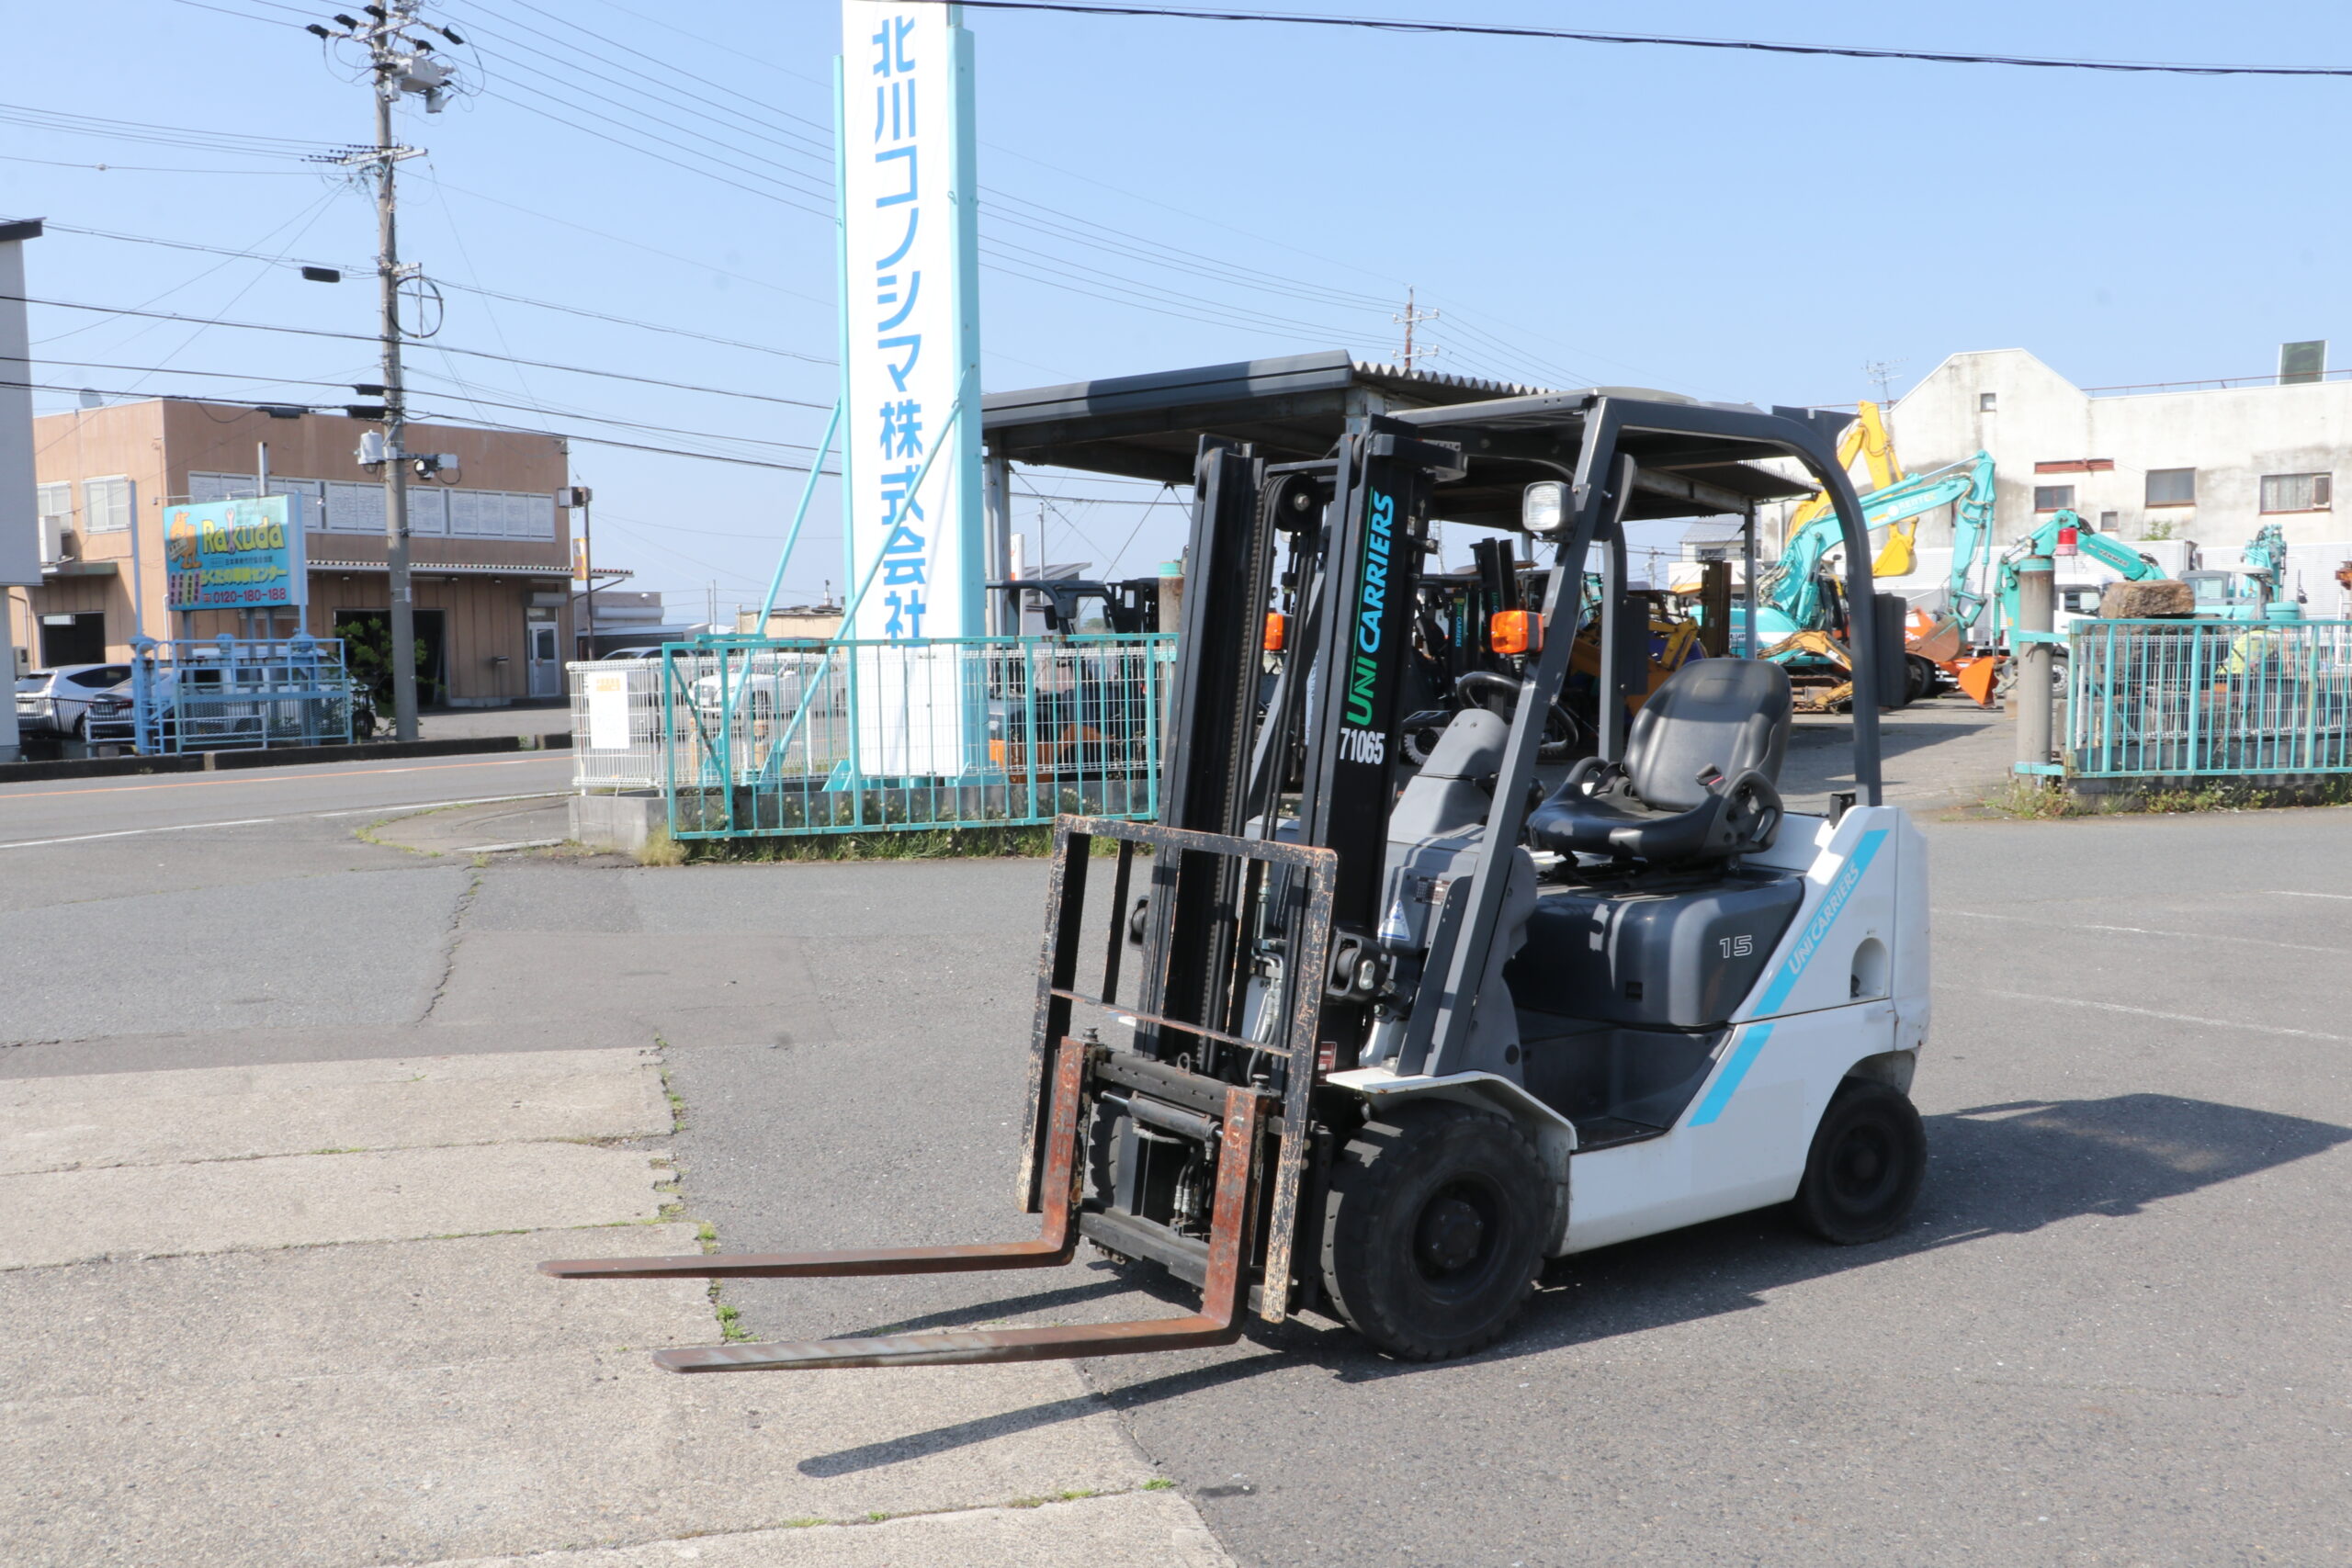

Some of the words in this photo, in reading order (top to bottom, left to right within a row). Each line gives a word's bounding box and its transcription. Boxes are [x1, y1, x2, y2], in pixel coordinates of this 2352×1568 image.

[872, 14, 927, 649] 北川コノシマ株式会社
[201, 513, 286, 555] Rakuda
[213, 588, 287, 604] 0120-180-188
[1339, 727, 1386, 765] 71065
[1719, 935, 1753, 958] 15
